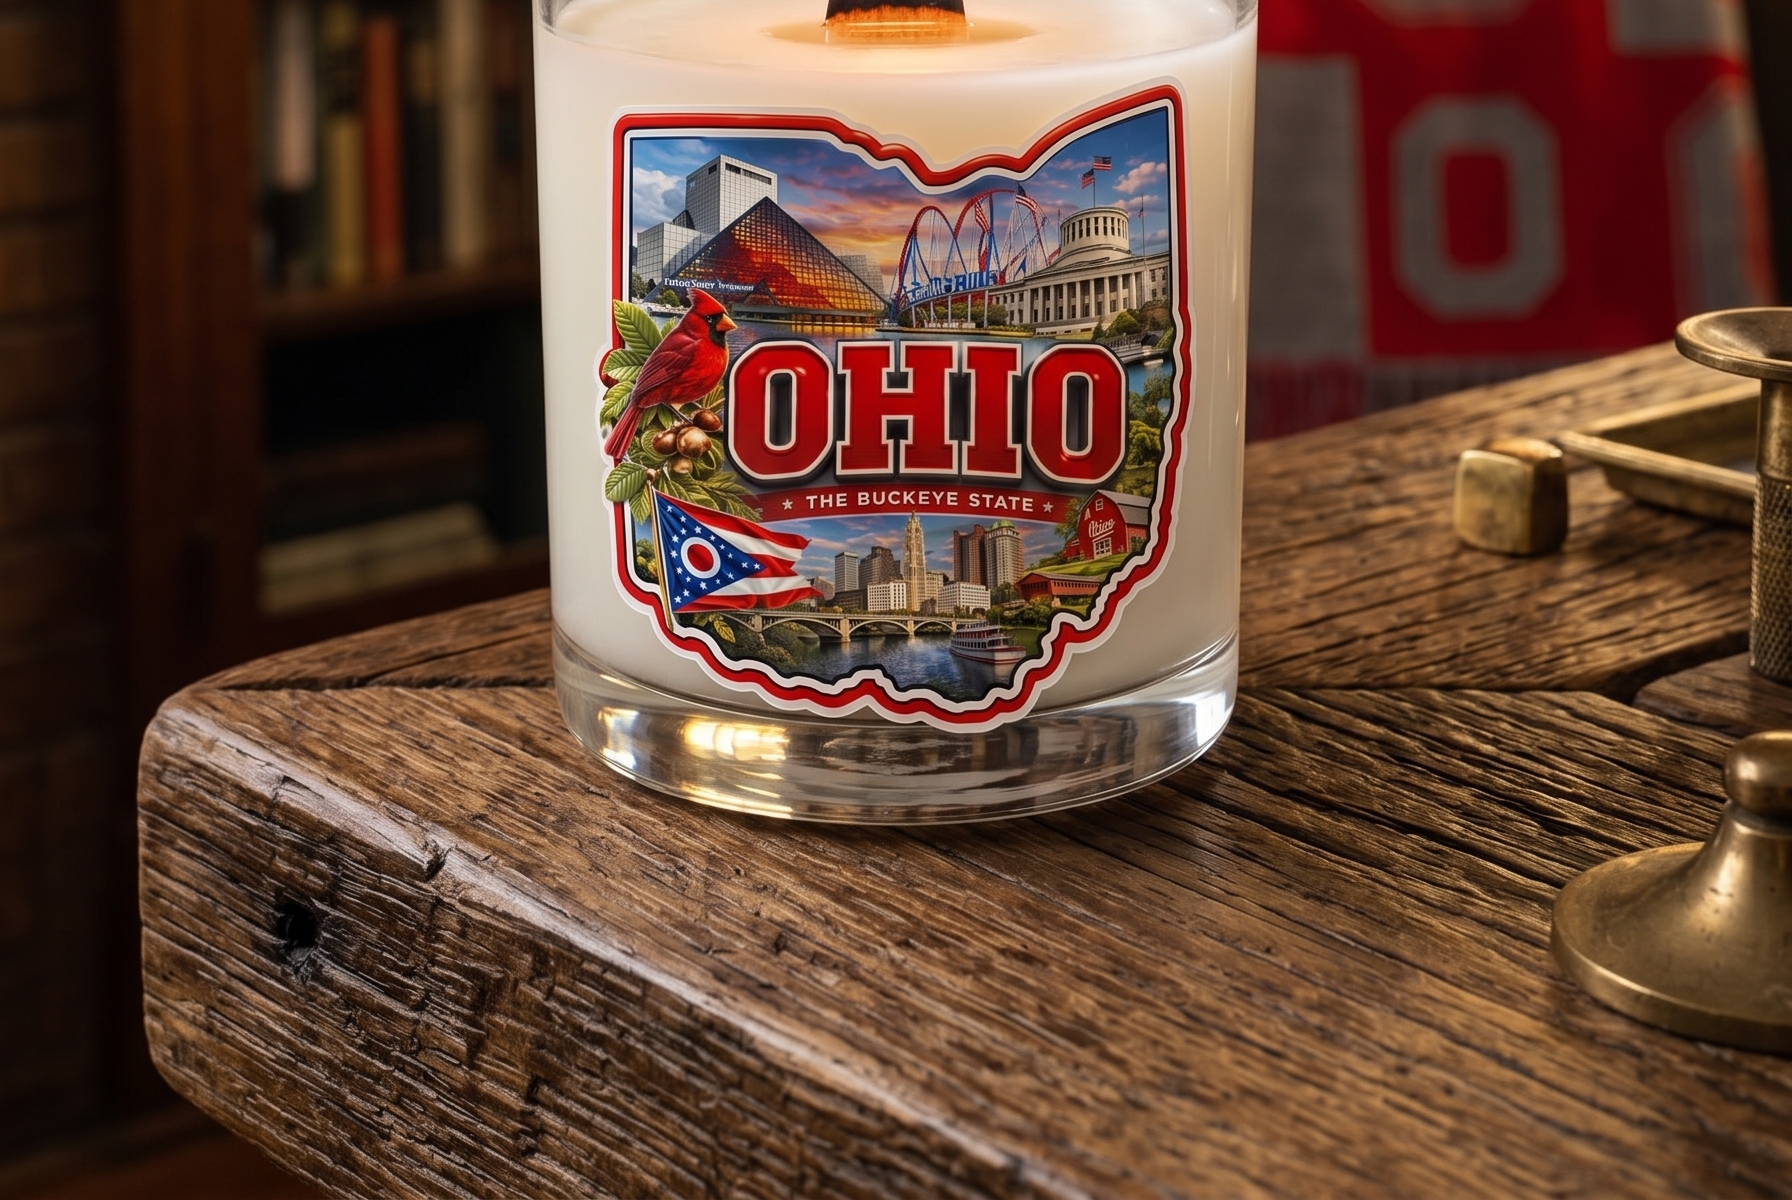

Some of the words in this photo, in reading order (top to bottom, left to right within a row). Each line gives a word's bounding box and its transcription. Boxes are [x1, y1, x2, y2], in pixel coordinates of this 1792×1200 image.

[727, 339, 1127, 485] OHIO
[806, 493, 848, 510] THE
[857, 490, 959, 507] BUCKEYE
[968, 493, 1034, 513] STATE
